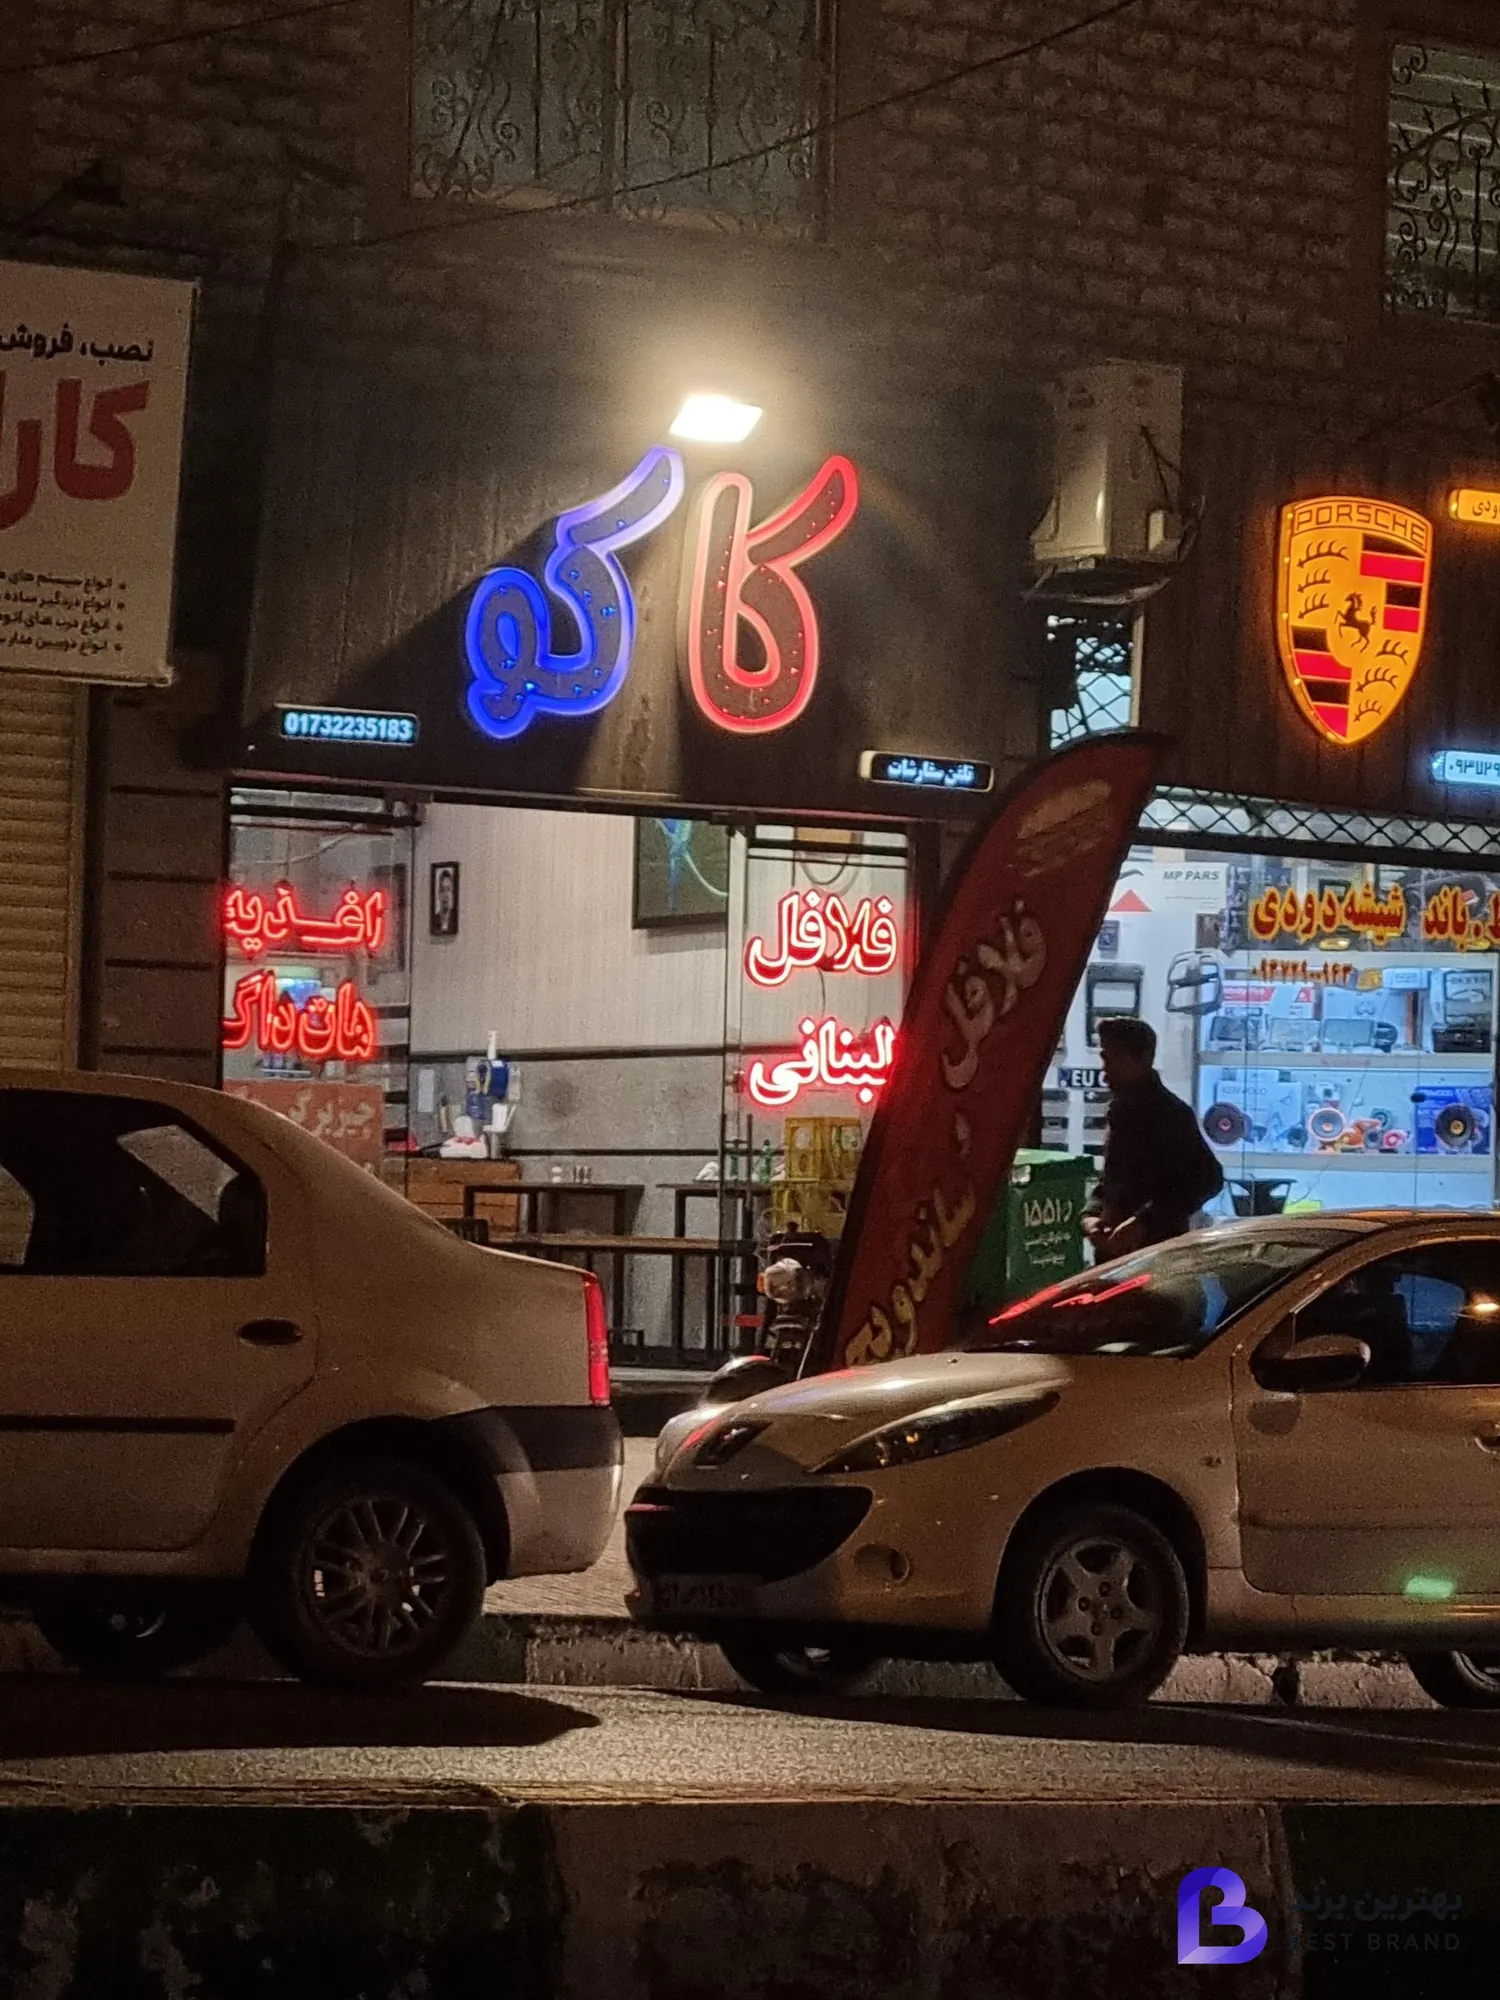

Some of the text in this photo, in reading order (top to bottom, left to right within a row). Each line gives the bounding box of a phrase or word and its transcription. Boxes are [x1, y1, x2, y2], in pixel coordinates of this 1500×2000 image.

[1296, 504, 1426, 547] PORSCHE
[283, 711, 413, 742] 01732235183
[1184, 870, 1220, 881] PARS
[745, 889, 897, 987] فلافل
